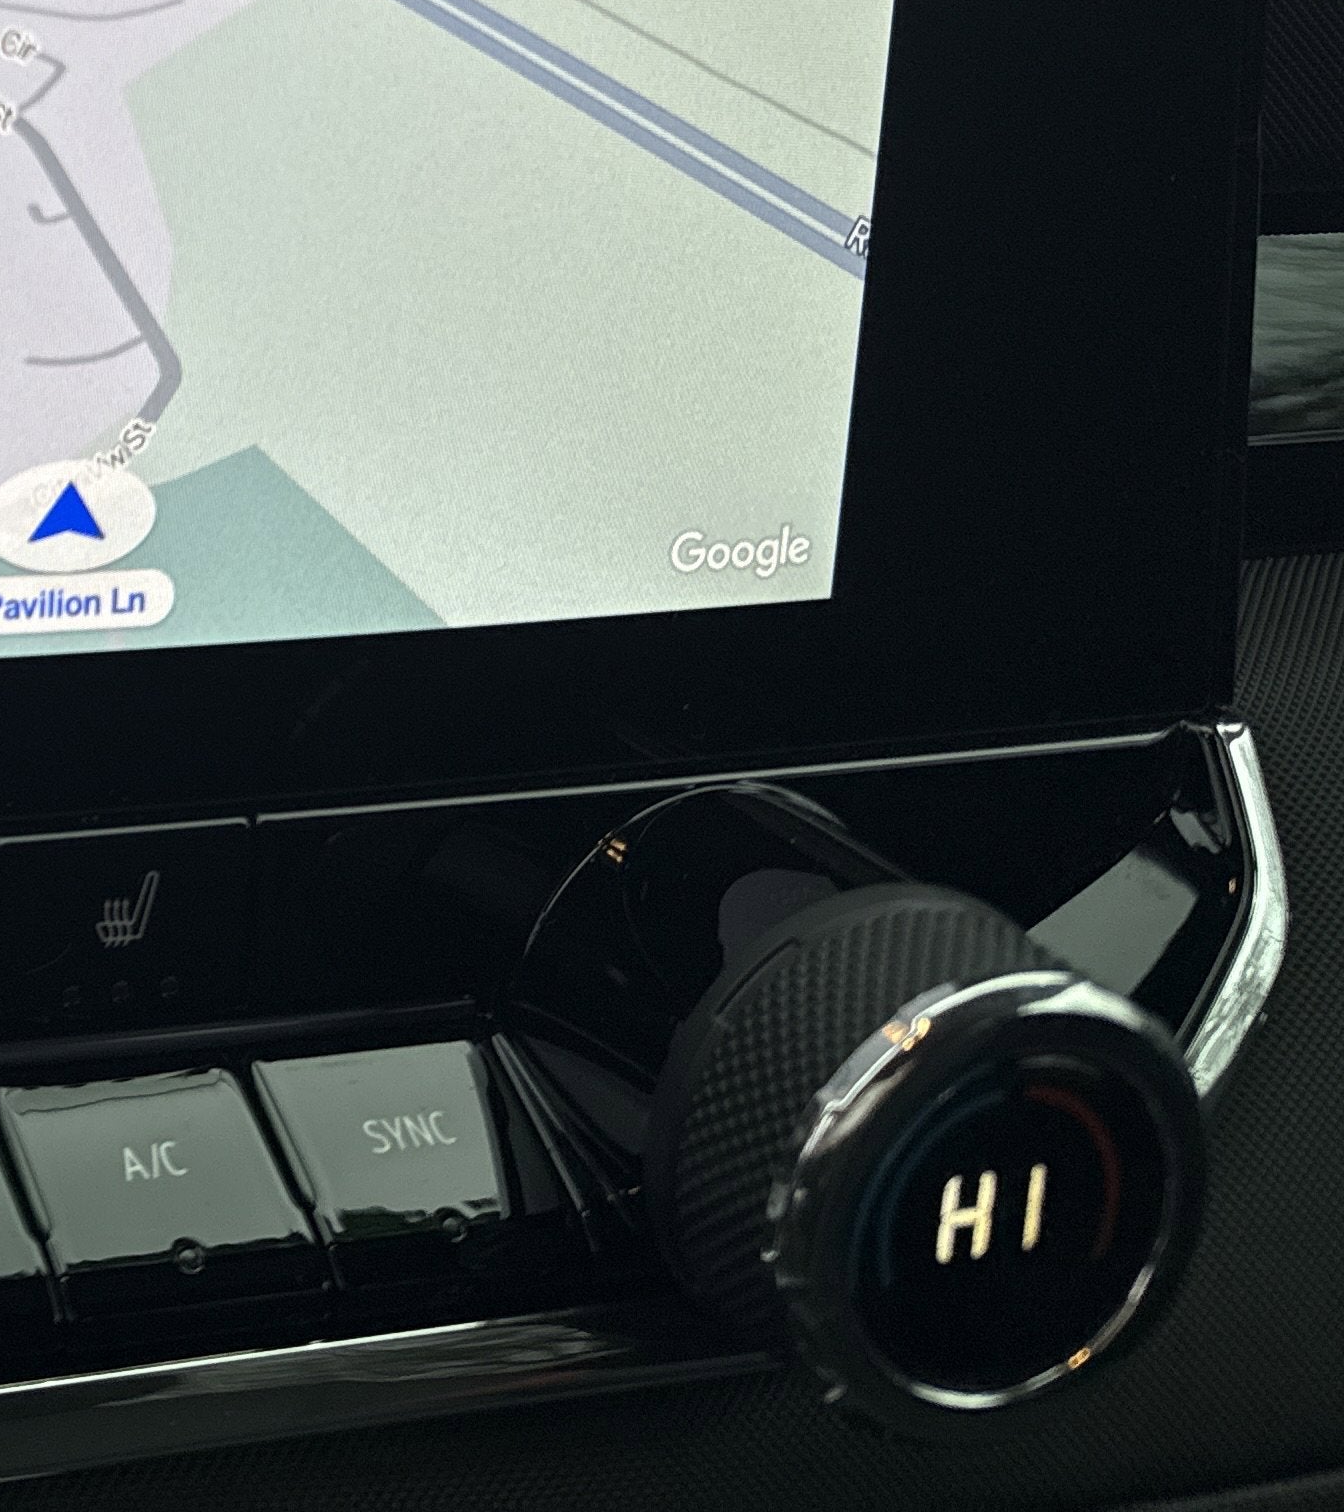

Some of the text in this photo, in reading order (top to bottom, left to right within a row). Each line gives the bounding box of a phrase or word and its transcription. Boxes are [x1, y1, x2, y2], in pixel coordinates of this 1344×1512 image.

[0, 28, 37, 59] Cir
[123, 421, 153, 451] St
[670, 525, 810, 578] Google
[110, 585, 147, 616] Ln
[362, 1109, 458, 1156] SYNC
[122, 1141, 189, 1182] A/C
[934, 1162, 1049, 1266] HI
